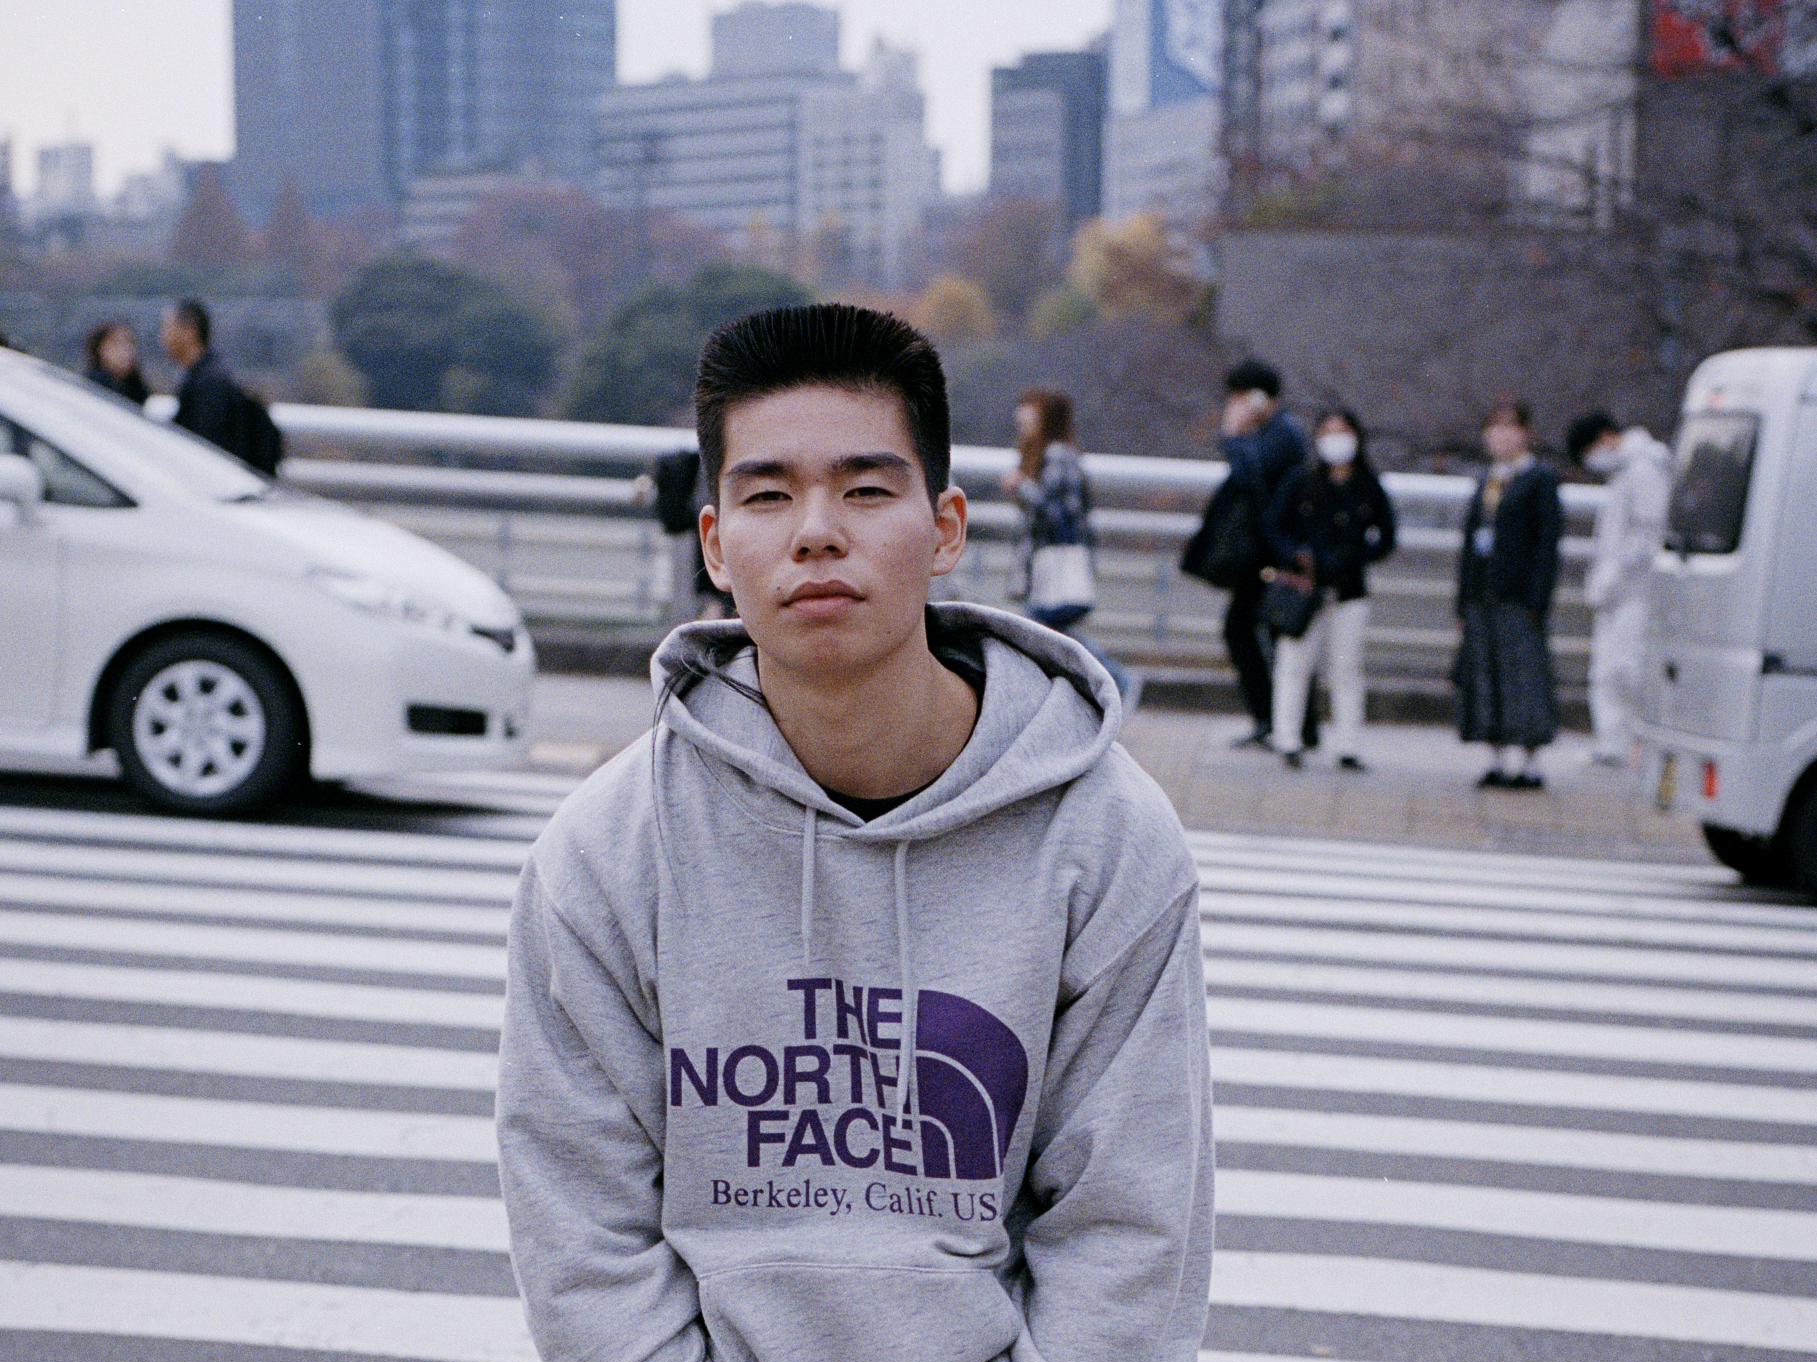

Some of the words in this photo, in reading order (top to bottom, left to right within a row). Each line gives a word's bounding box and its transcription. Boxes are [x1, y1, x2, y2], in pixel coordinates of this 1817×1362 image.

[787, 978, 903, 1050] THE
[670, 1044, 912, 1115] NORTH
[747, 1107, 918, 1176] FACE
[711, 1179, 852, 1215] Berkeley,
[865, 1182, 943, 1218] Calif.
